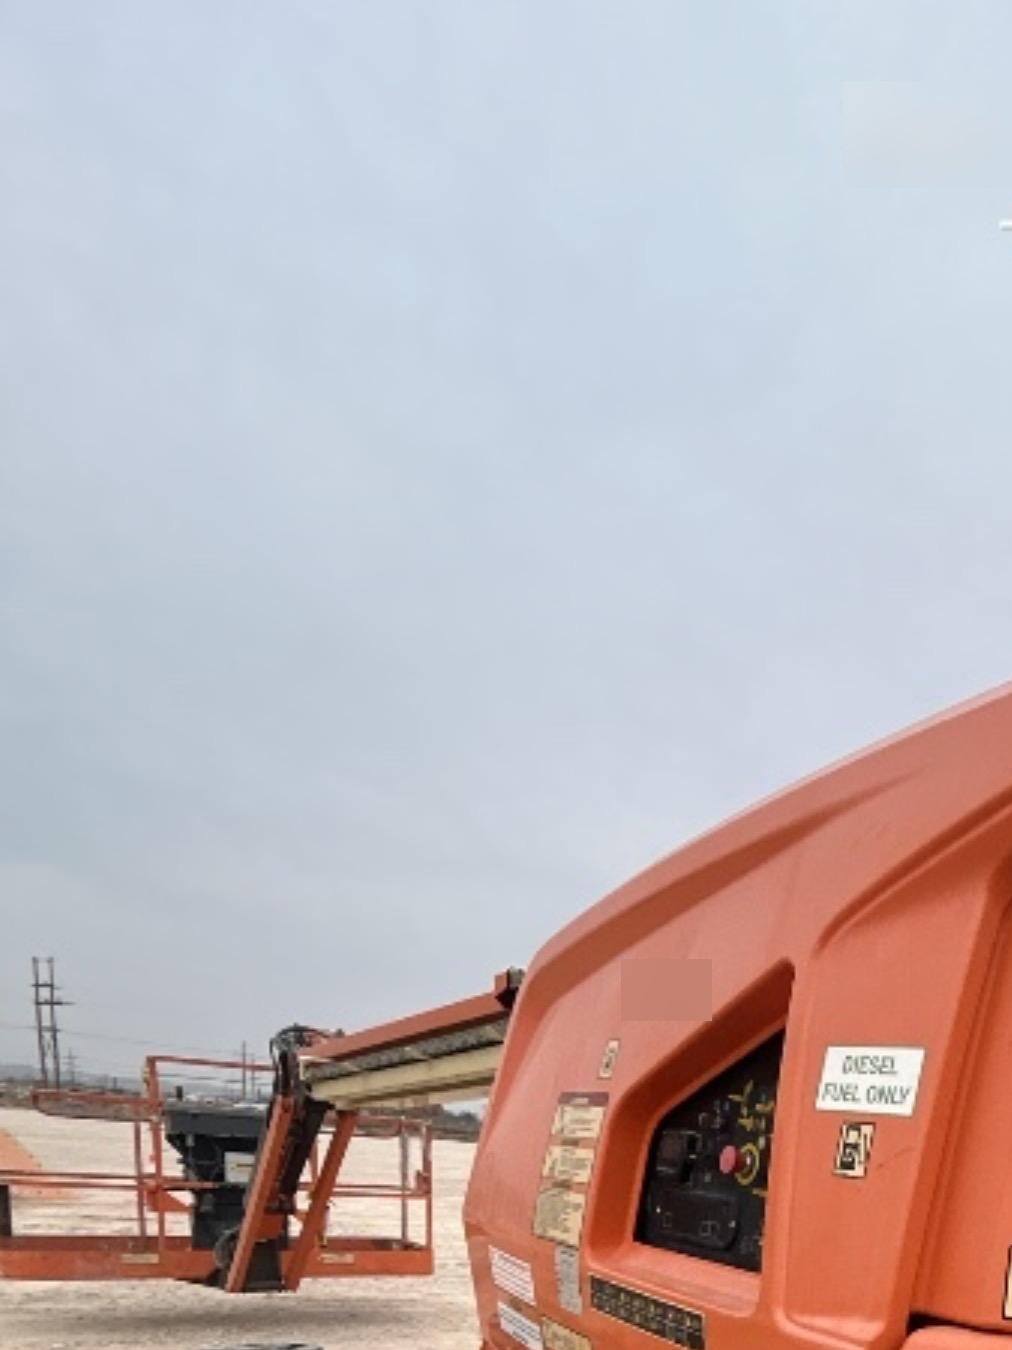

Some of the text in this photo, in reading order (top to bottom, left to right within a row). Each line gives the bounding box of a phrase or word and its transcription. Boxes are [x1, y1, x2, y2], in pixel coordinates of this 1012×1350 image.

[842, 1055, 897, 1075] DIESEL
[821, 1082, 912, 1105] FUEL ONLY
